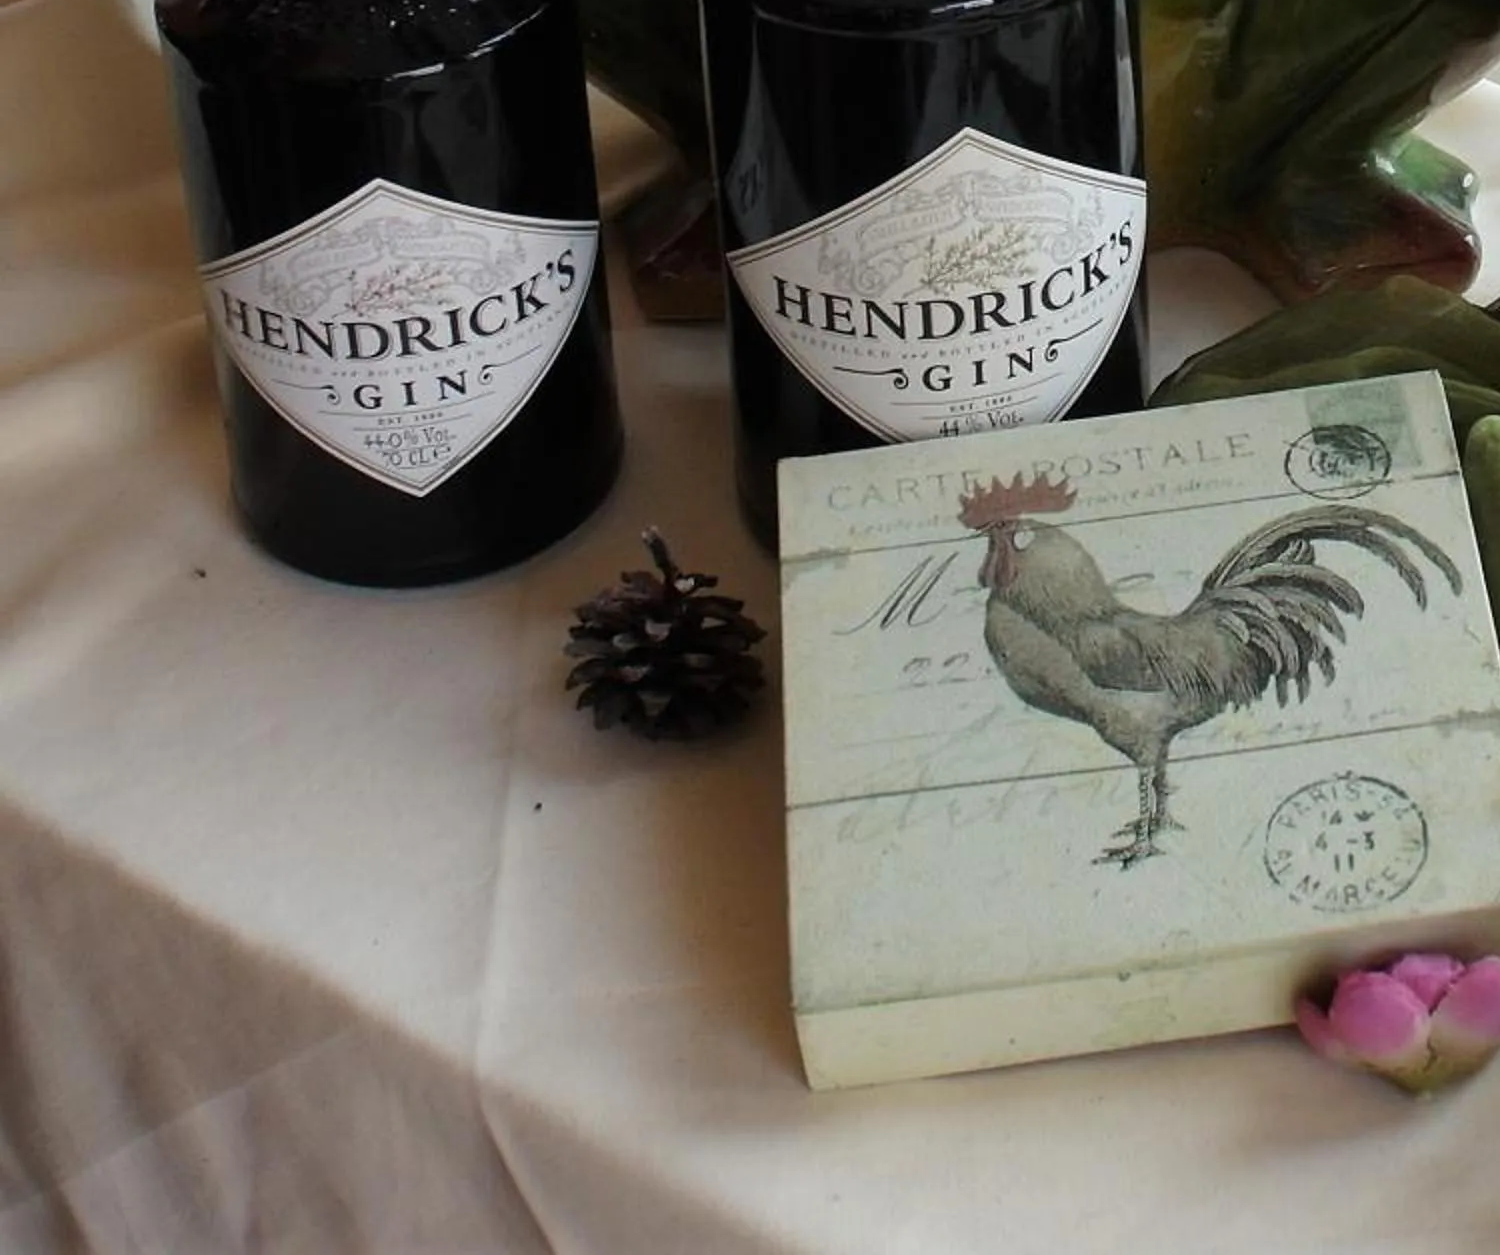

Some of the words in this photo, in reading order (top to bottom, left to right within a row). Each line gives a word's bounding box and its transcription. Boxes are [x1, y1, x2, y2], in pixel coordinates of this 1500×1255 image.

[219, 248, 576, 360] HENDRICK'S
[773, 220, 1133, 341] HENDRICK'S
[353, 369, 468, 410] GIN
[922, 346, 1035, 392] GIN
[828, 469, 984, 512] CARTE
[1031, 433, 1255, 478] POSTALE
